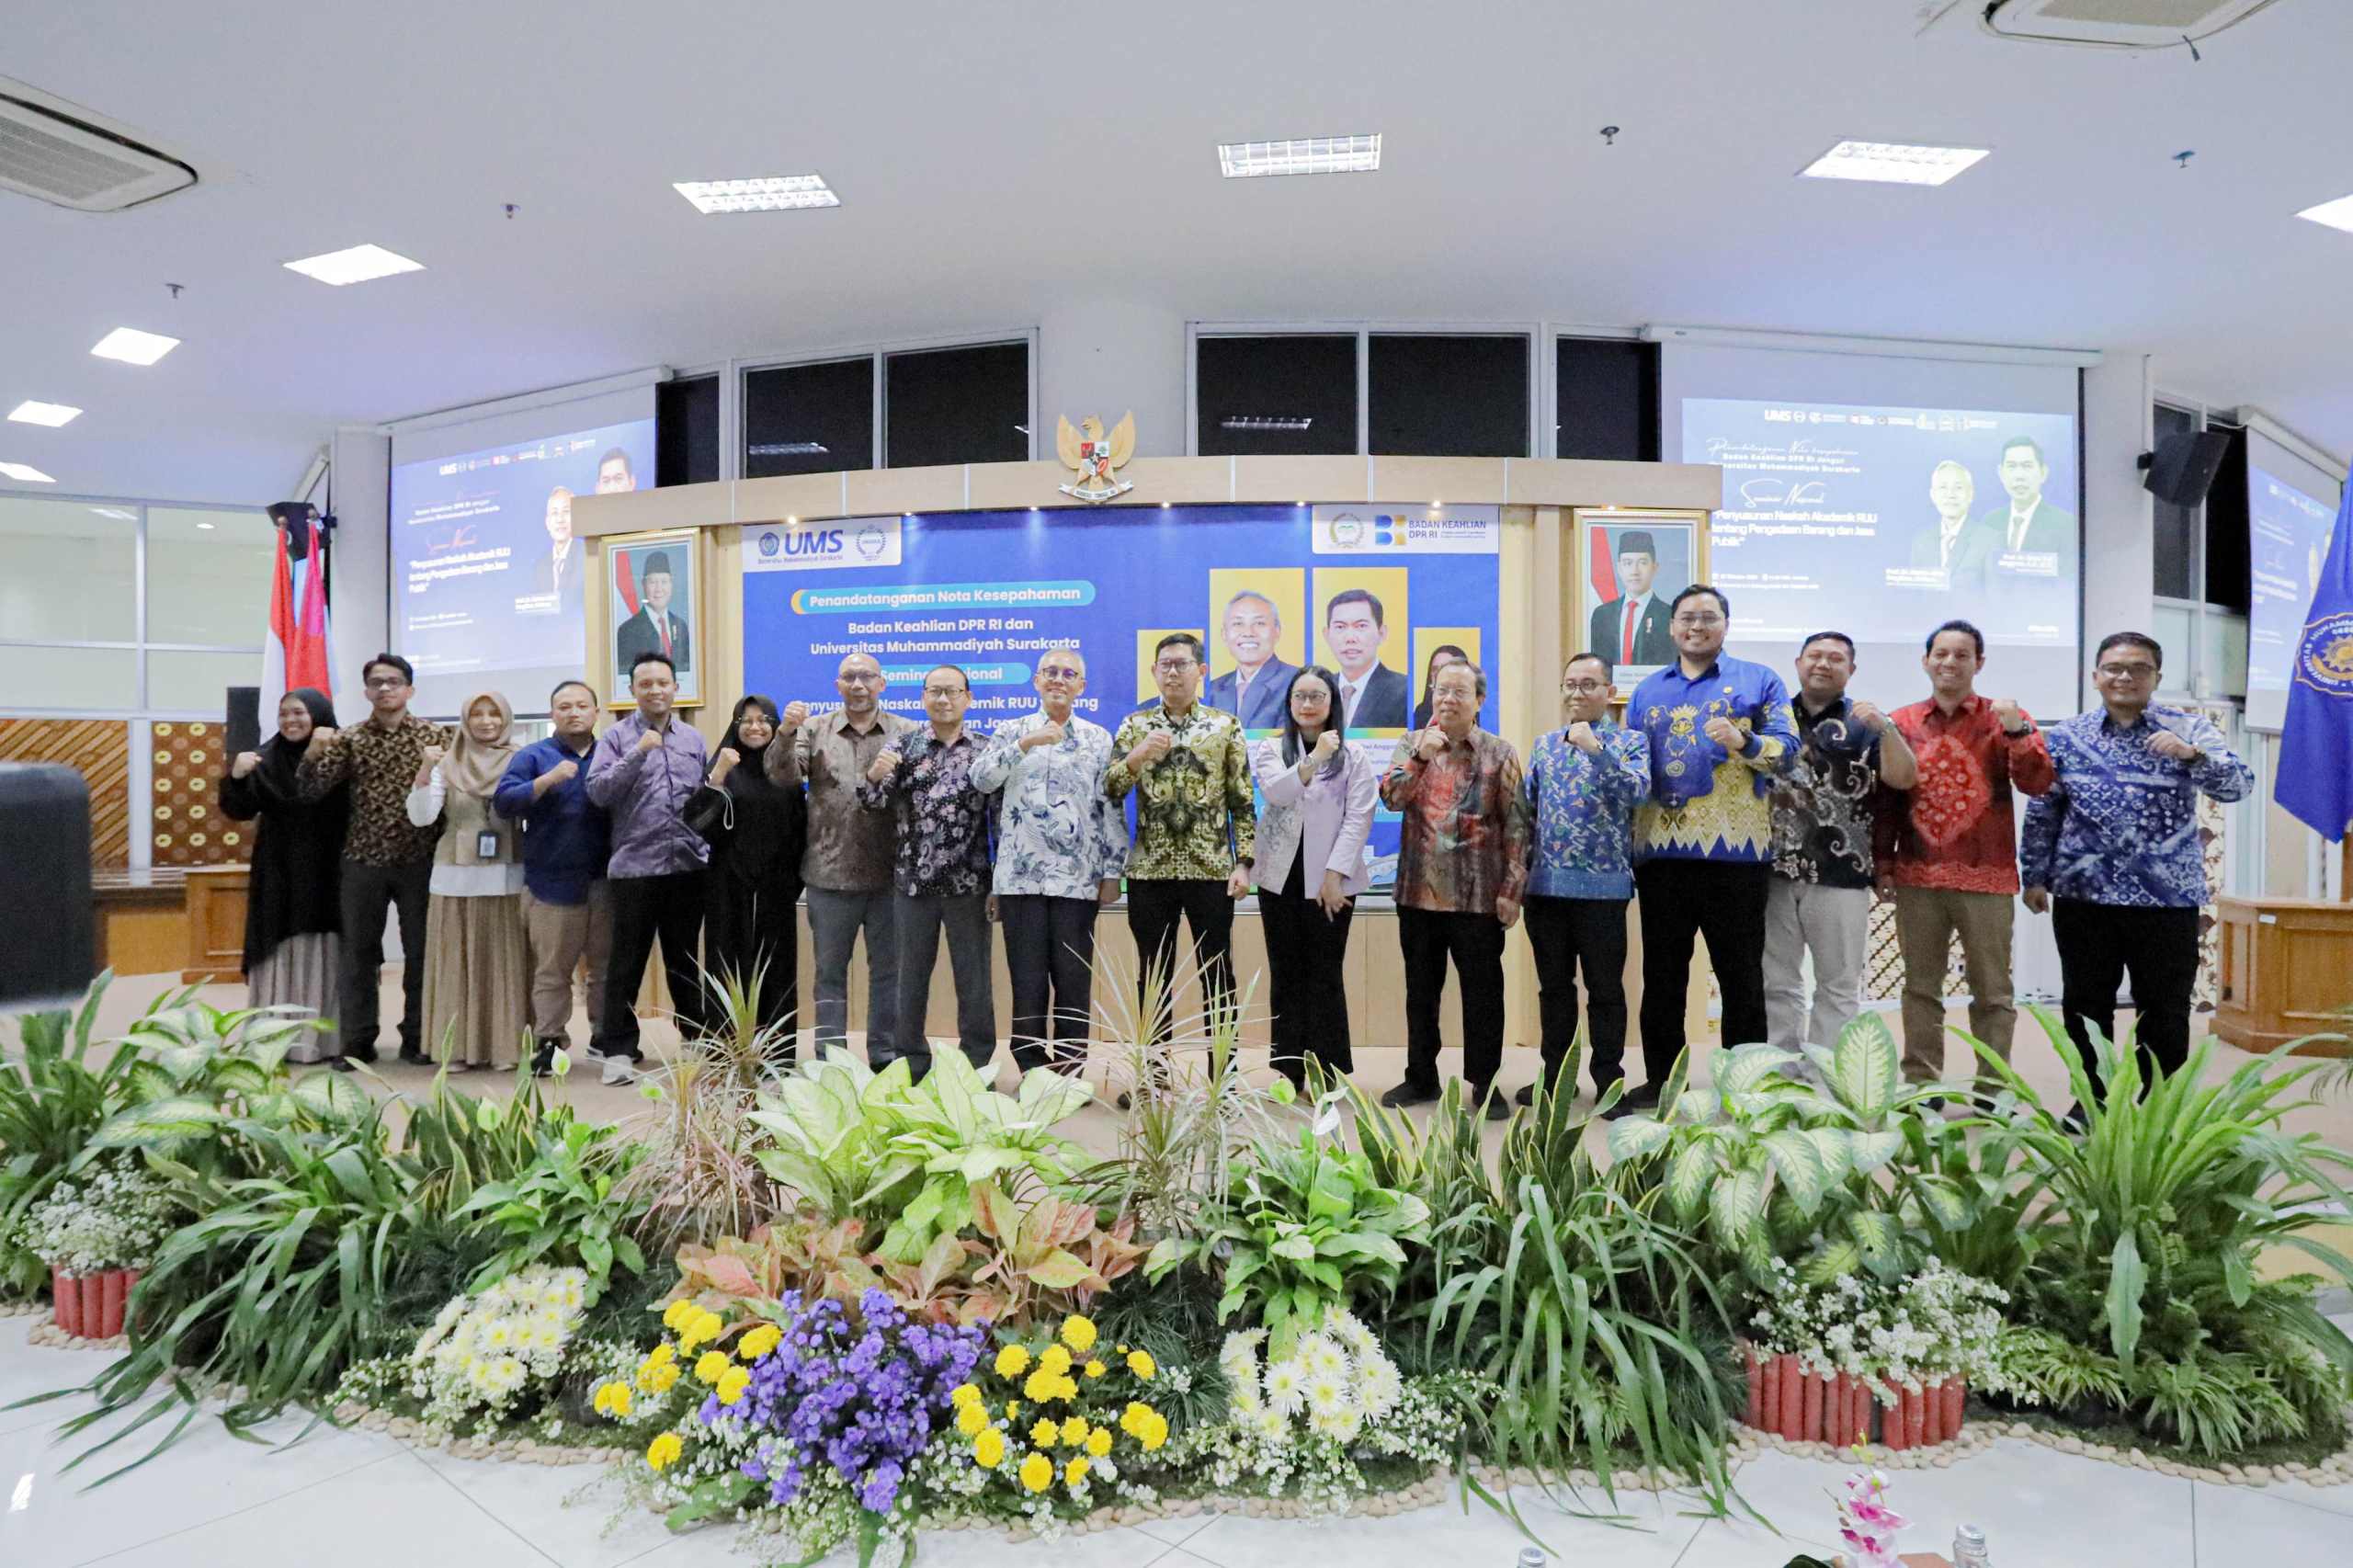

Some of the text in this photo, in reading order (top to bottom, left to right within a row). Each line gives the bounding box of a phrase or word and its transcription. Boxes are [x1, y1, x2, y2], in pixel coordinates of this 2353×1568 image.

[1764, 409, 1791, 422] UMS
[1759, 461, 1820, 472] Muhammadiyah
[1740, 478, 1825, 508] Seminar Nasional
[1409, 520, 1486, 528] BADAN KEAHLIAN
[1775, 510, 1811, 522] Naskah
[1811, 511, 1857, 523] Akademik
[1857, 513, 1878, 524] RUU
[1409, 530, 1427, 539] DPR
[1428, 530, 1438, 539] RI
[1711, 522, 1747, 536] tentang
[1748, 523, 1802, 537] Pengadaan
[1802, 525, 1836, 538] Barang
[1836, 526, 1854, 536] dan
[785, 529, 844, 555] UMS
[810, 587, 1081, 608] Penandatanganan Nota Kesepahaman
[848, 618, 1034, 634] Badan Keahlian DPR RI dan
[811, 641, 884, 654] Universitas
[887, 638, 1004, 654] Muhammadiyah
[1008, 697, 1038, 709] RUU
